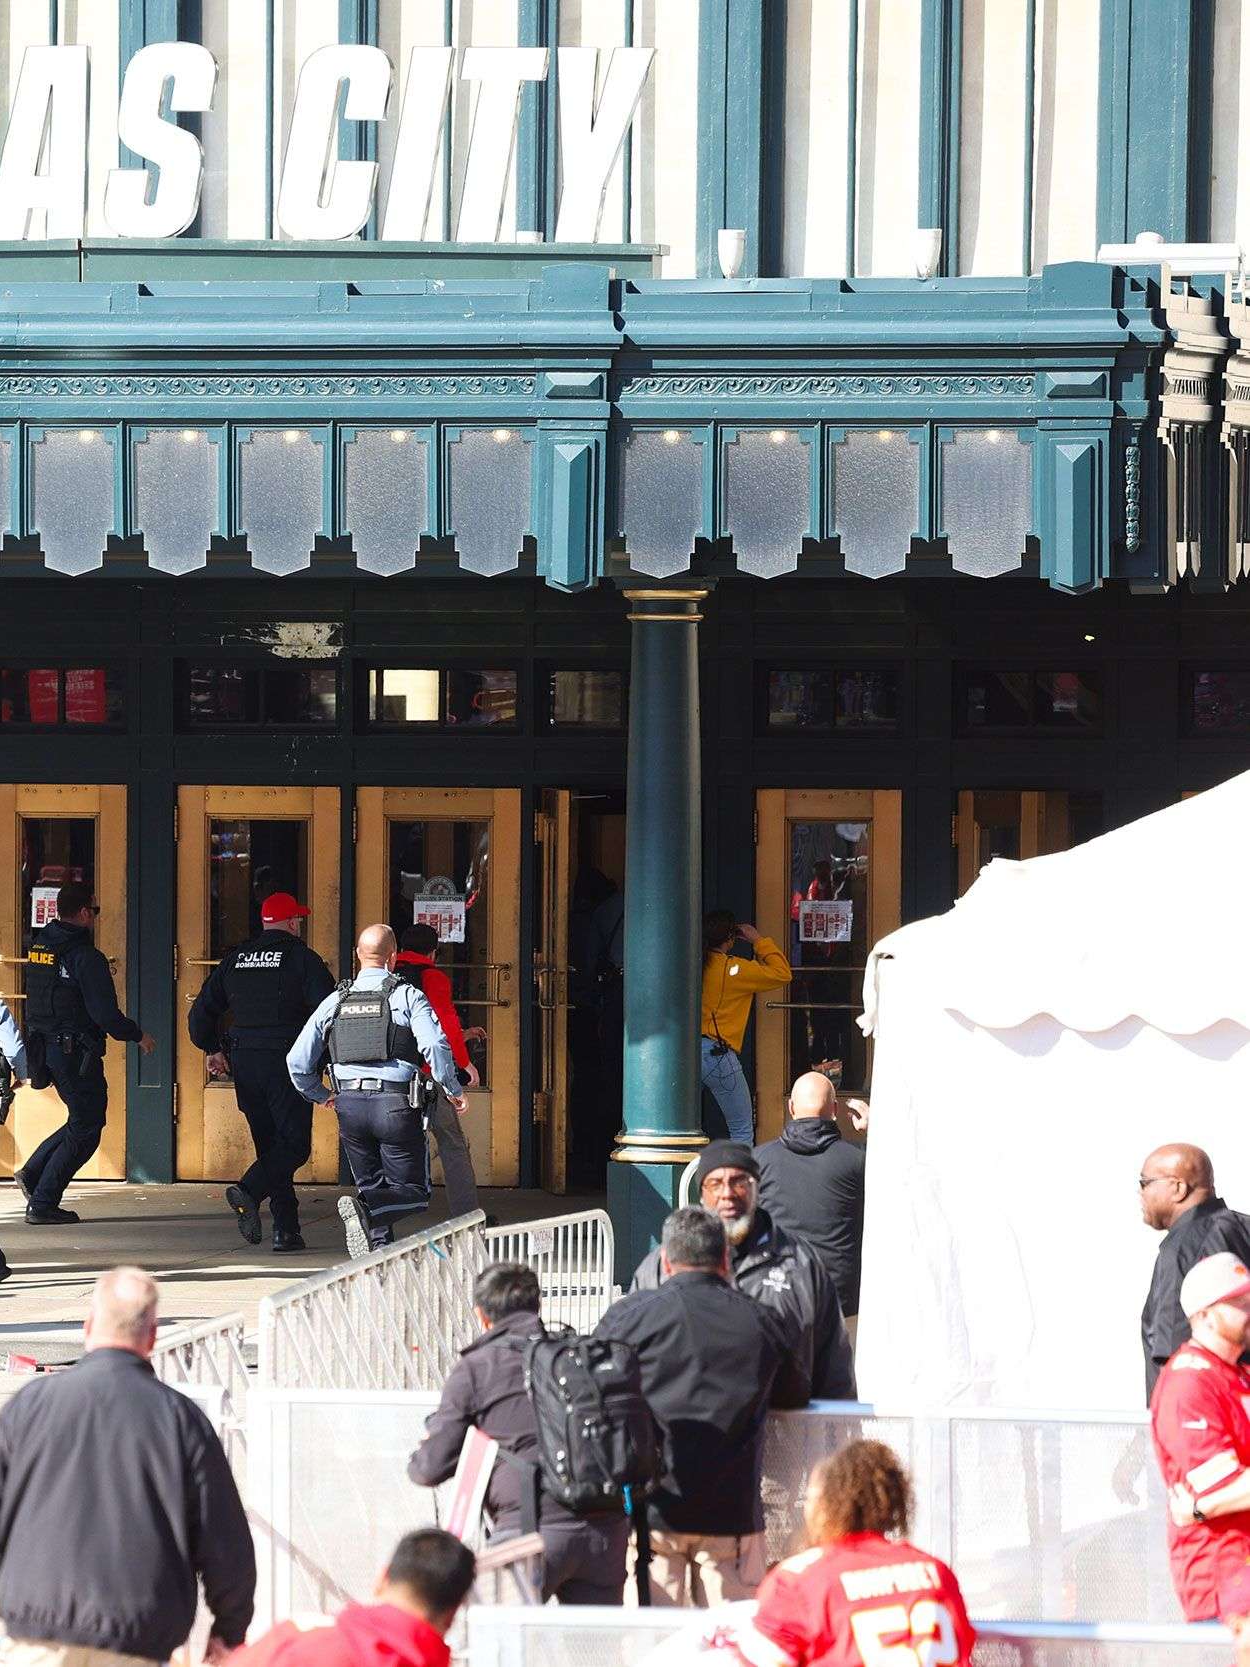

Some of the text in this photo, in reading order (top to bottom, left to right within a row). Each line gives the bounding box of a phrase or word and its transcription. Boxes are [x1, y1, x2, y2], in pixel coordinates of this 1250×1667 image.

[277, 44, 657, 243] CITY
[28, 950, 55, 965] POLICE
[238, 951, 283, 962] POLICE
[341, 1004, 381, 1015] POLICE
